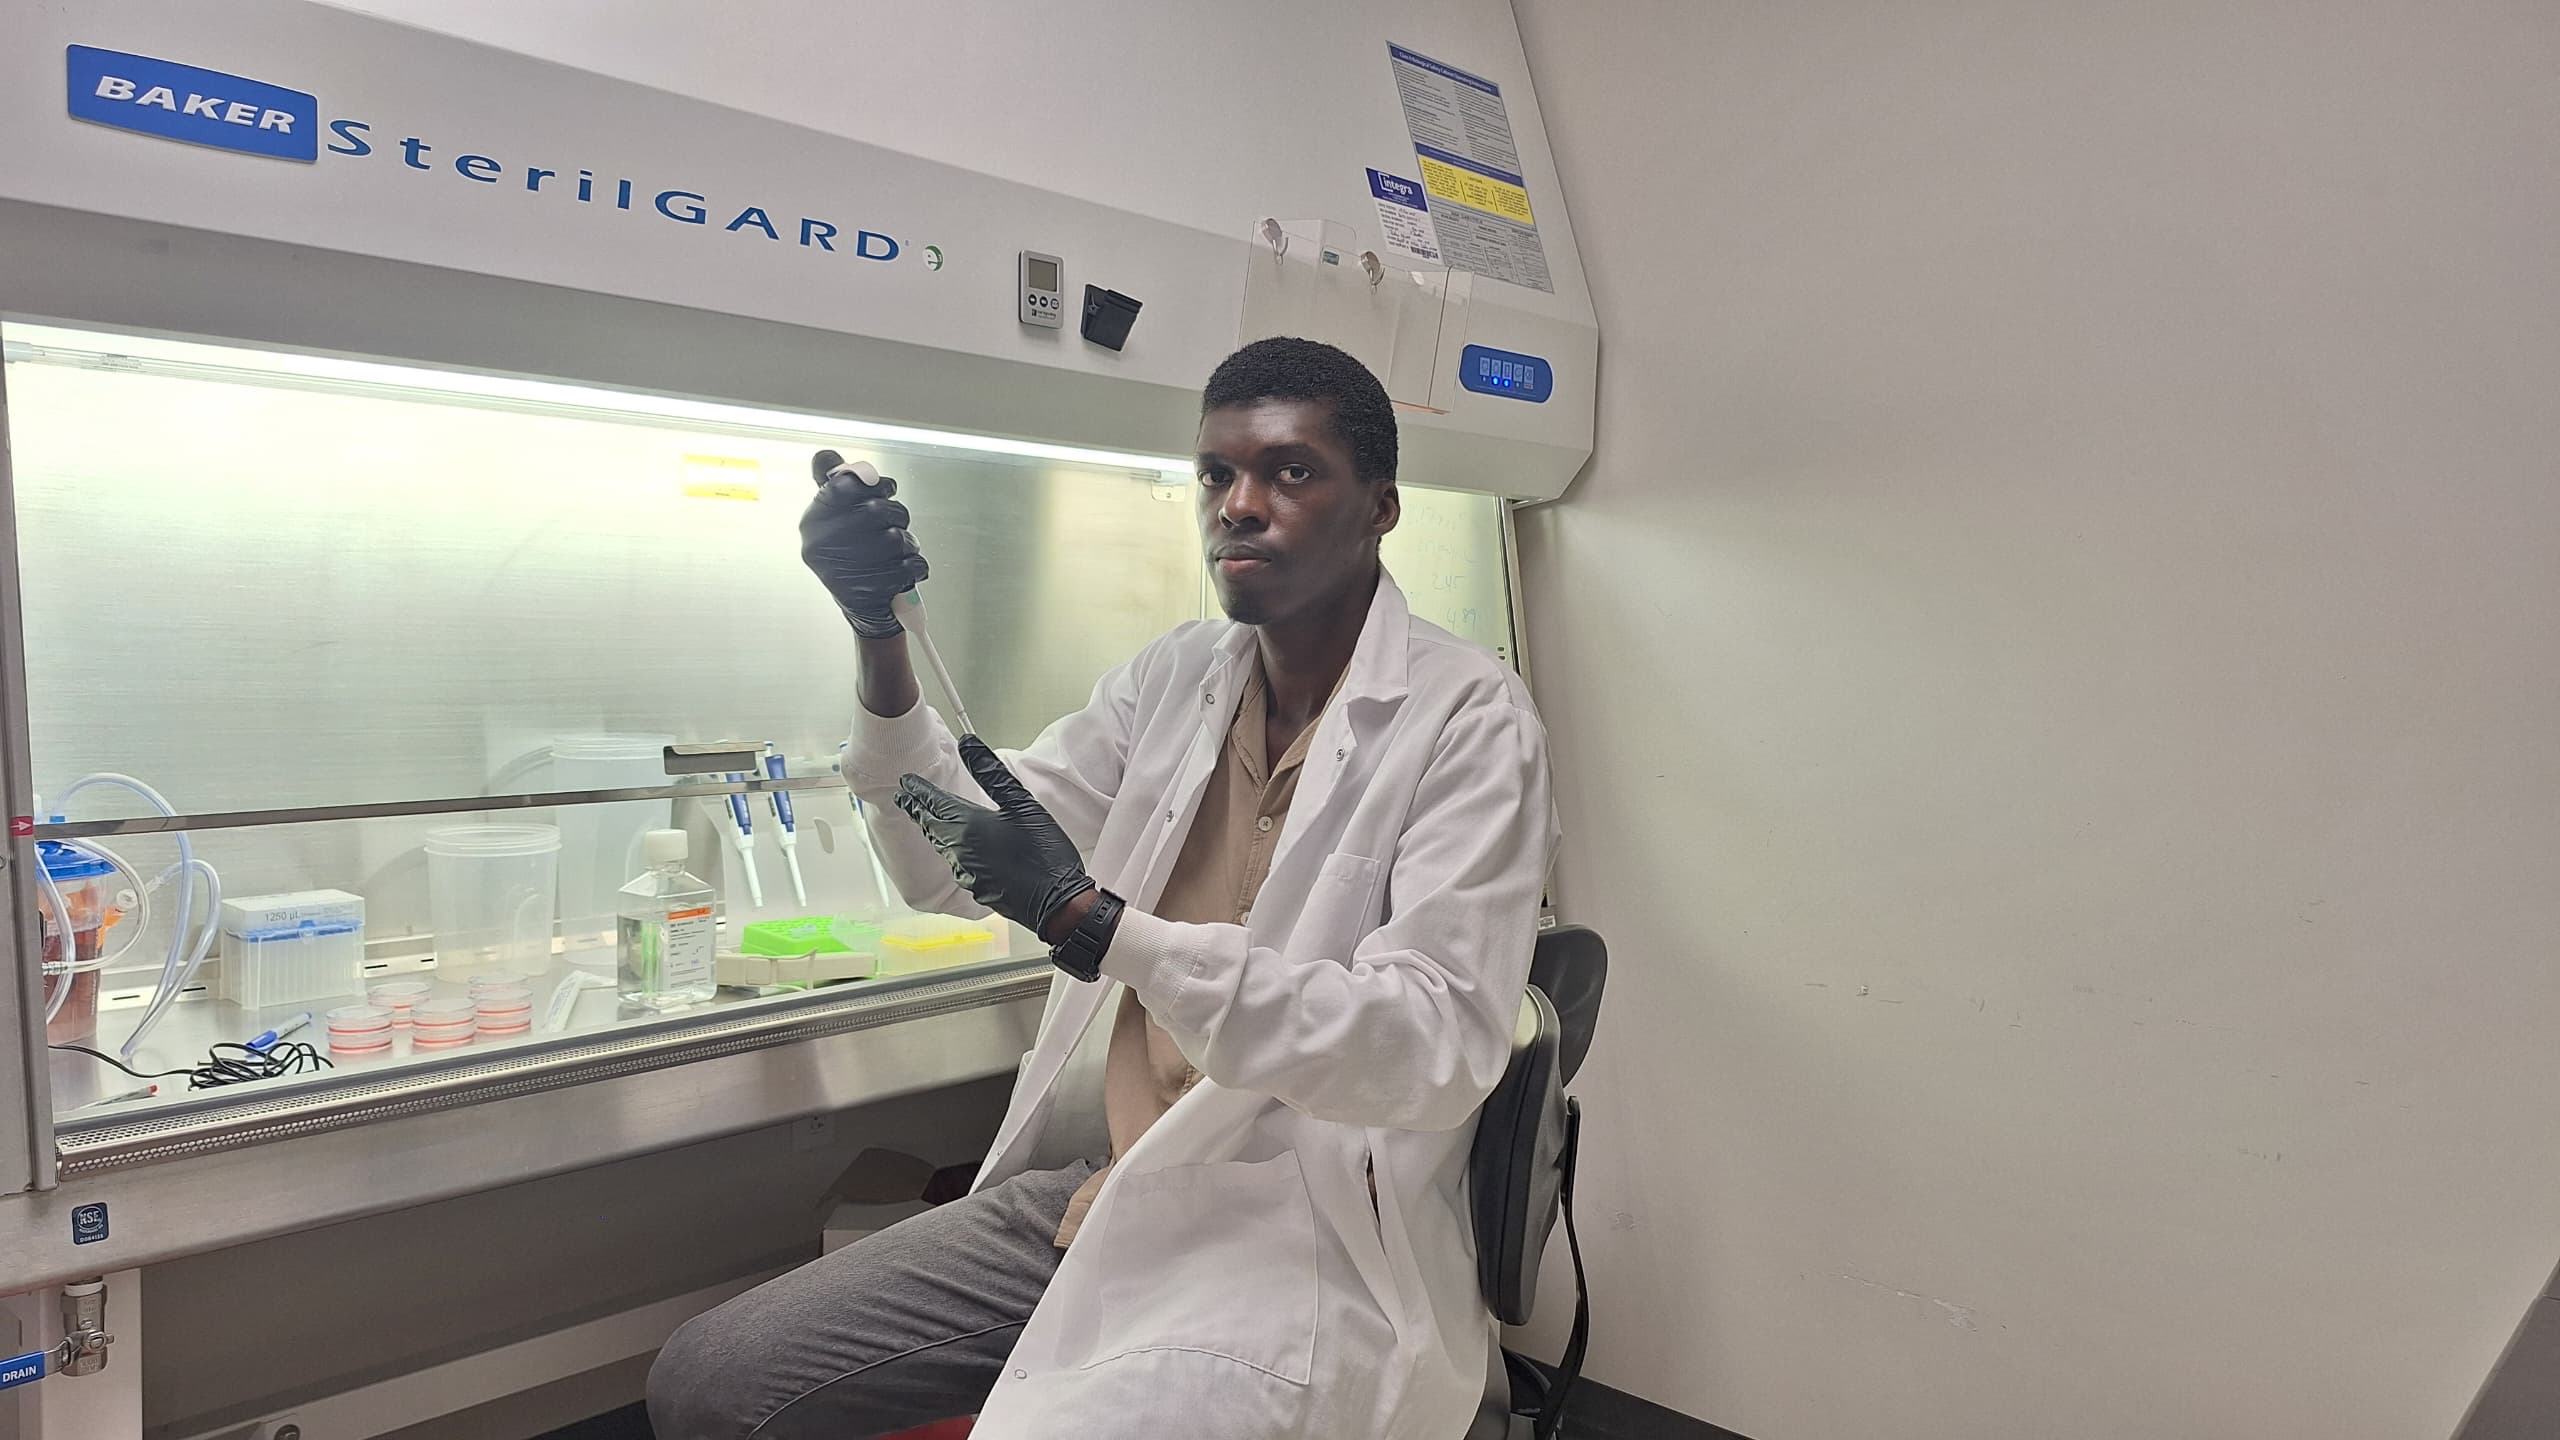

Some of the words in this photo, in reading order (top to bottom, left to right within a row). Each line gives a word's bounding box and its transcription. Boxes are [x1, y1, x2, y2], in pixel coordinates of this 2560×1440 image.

[95, 75, 295, 134] BAKER
[326, 118, 901, 263] SterilGARD
[265, 911, 287, 922] 1250
[2, 1365, 37, 1383] DRAIN
